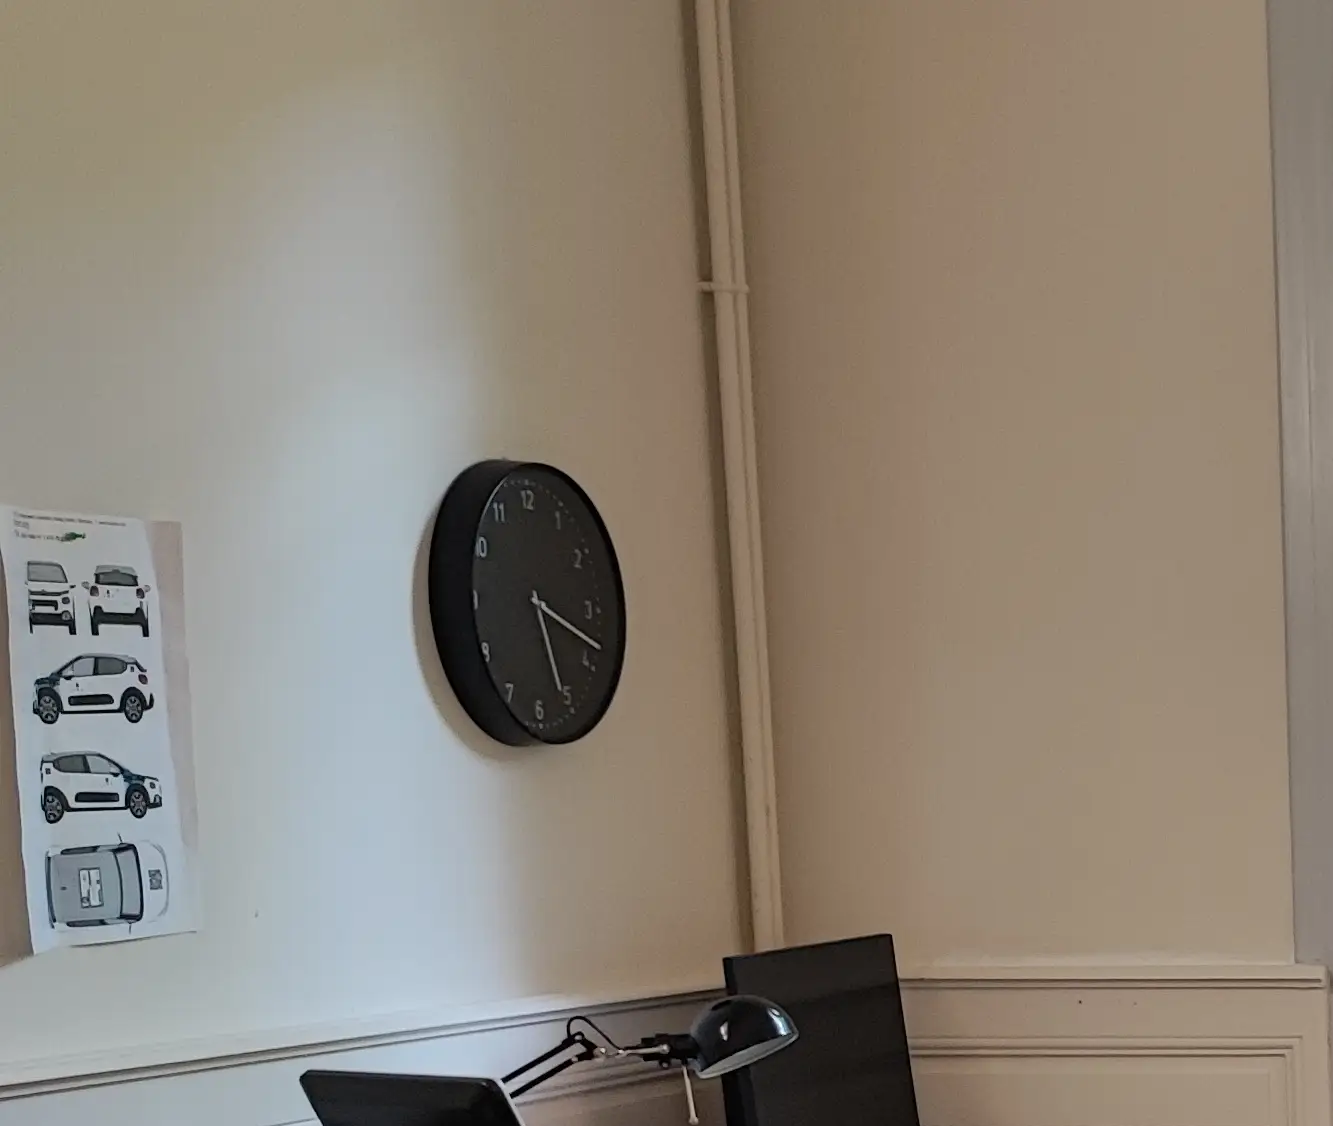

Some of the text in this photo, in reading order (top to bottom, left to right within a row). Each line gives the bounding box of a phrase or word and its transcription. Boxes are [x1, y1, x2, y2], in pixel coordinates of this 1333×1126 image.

[521, 490, 534, 510] 12
[493, 502, 505, 522] 11
[574, 549, 582, 569] 2
[585, 600, 592, 620] 3
[505, 682, 514, 703] 7
[563, 685, 572, 706] 5
[535, 700, 544, 720] 6
